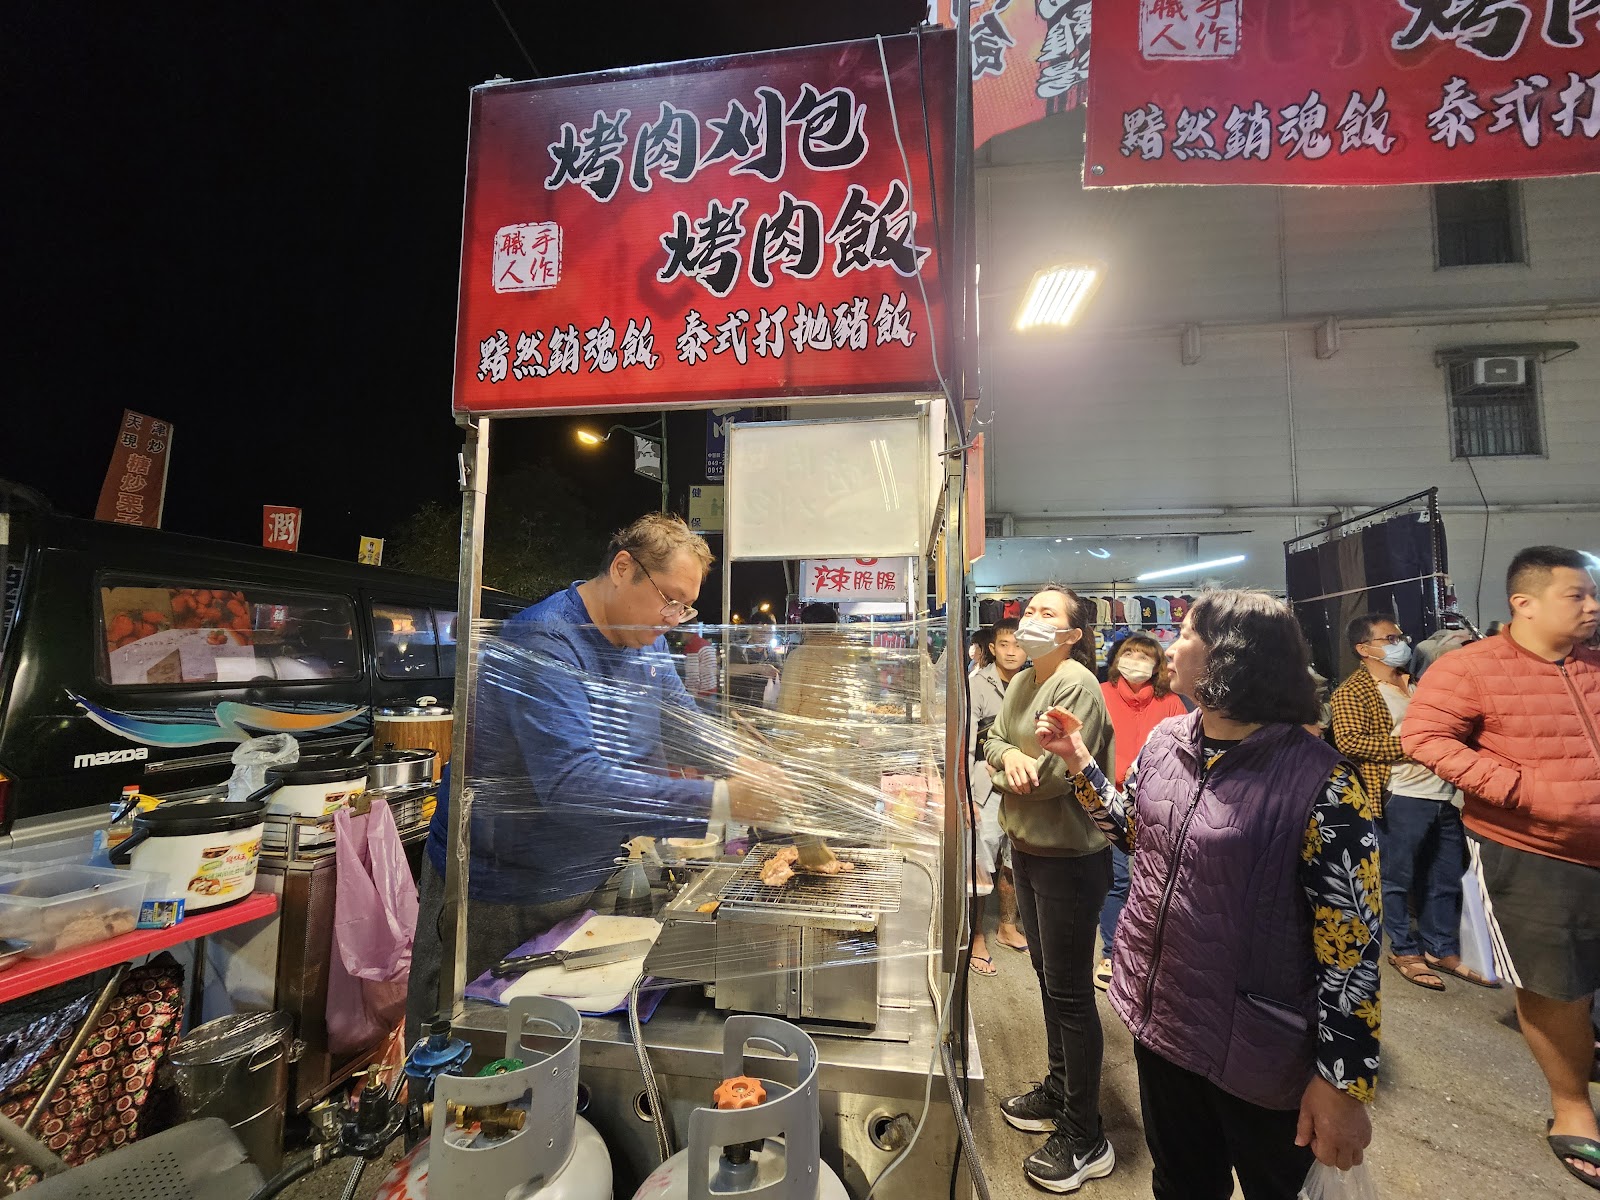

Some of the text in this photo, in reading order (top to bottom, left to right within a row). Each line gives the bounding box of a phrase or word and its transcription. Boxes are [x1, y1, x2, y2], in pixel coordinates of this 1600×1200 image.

[544, 84, 869, 203] 烤肉刈包
[1120, 87, 1397, 161] 黯然銷魂飯
[657, 179, 932, 297] 烤肉飯
[476, 316, 660, 384] 黯然銷魂飯
